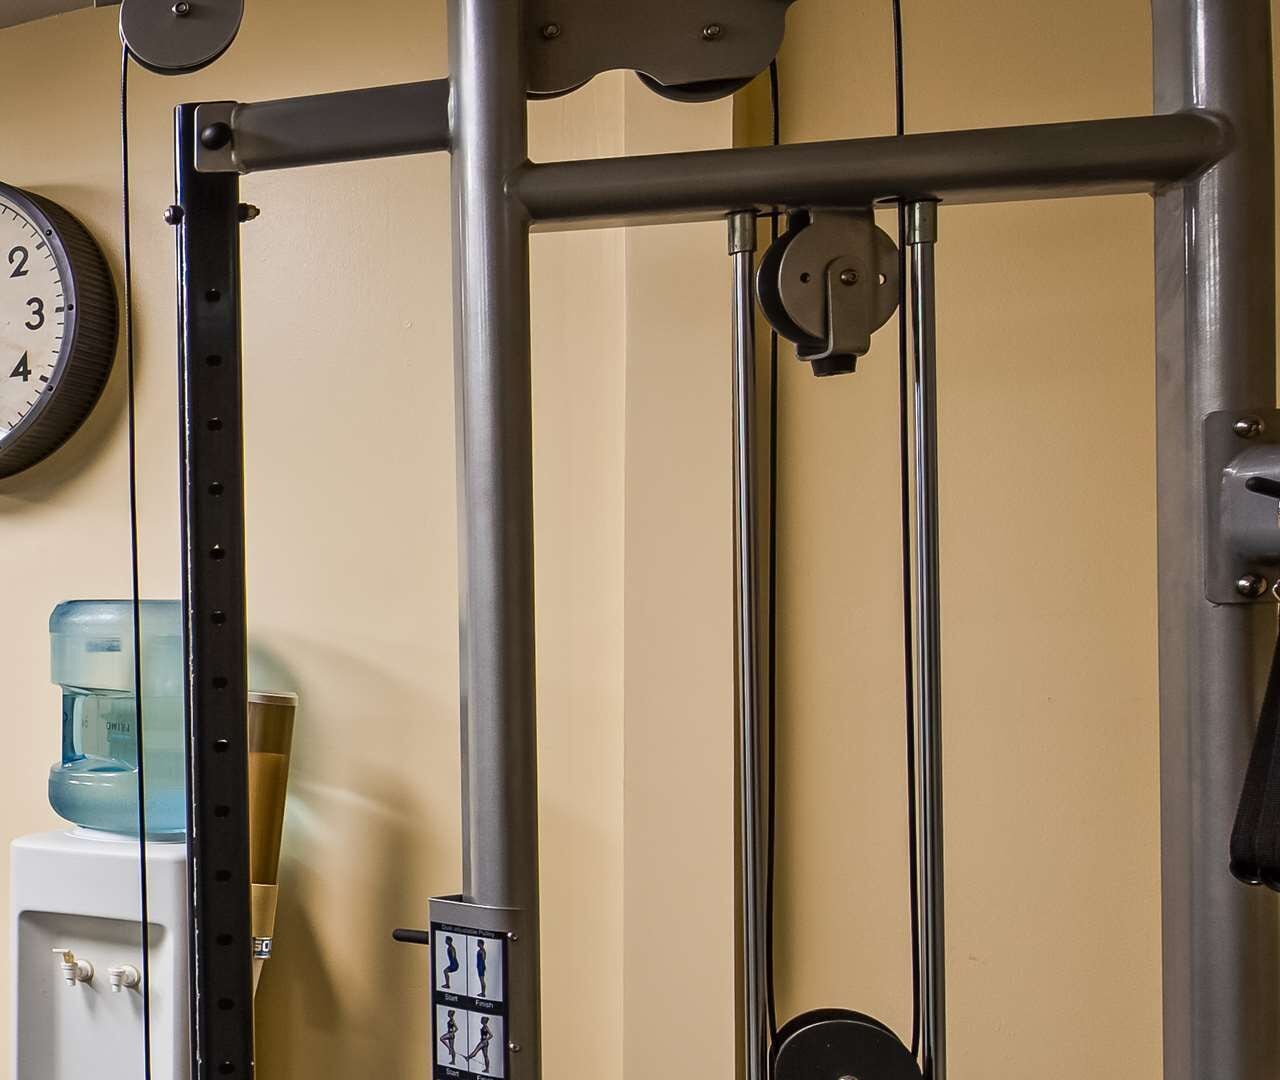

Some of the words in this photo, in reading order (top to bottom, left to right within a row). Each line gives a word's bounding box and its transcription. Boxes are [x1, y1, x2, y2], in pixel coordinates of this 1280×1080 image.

[8, 246, 29, 278] 2
[24, 297, 45, 330] 3
[9, 350, 32, 382] 4
